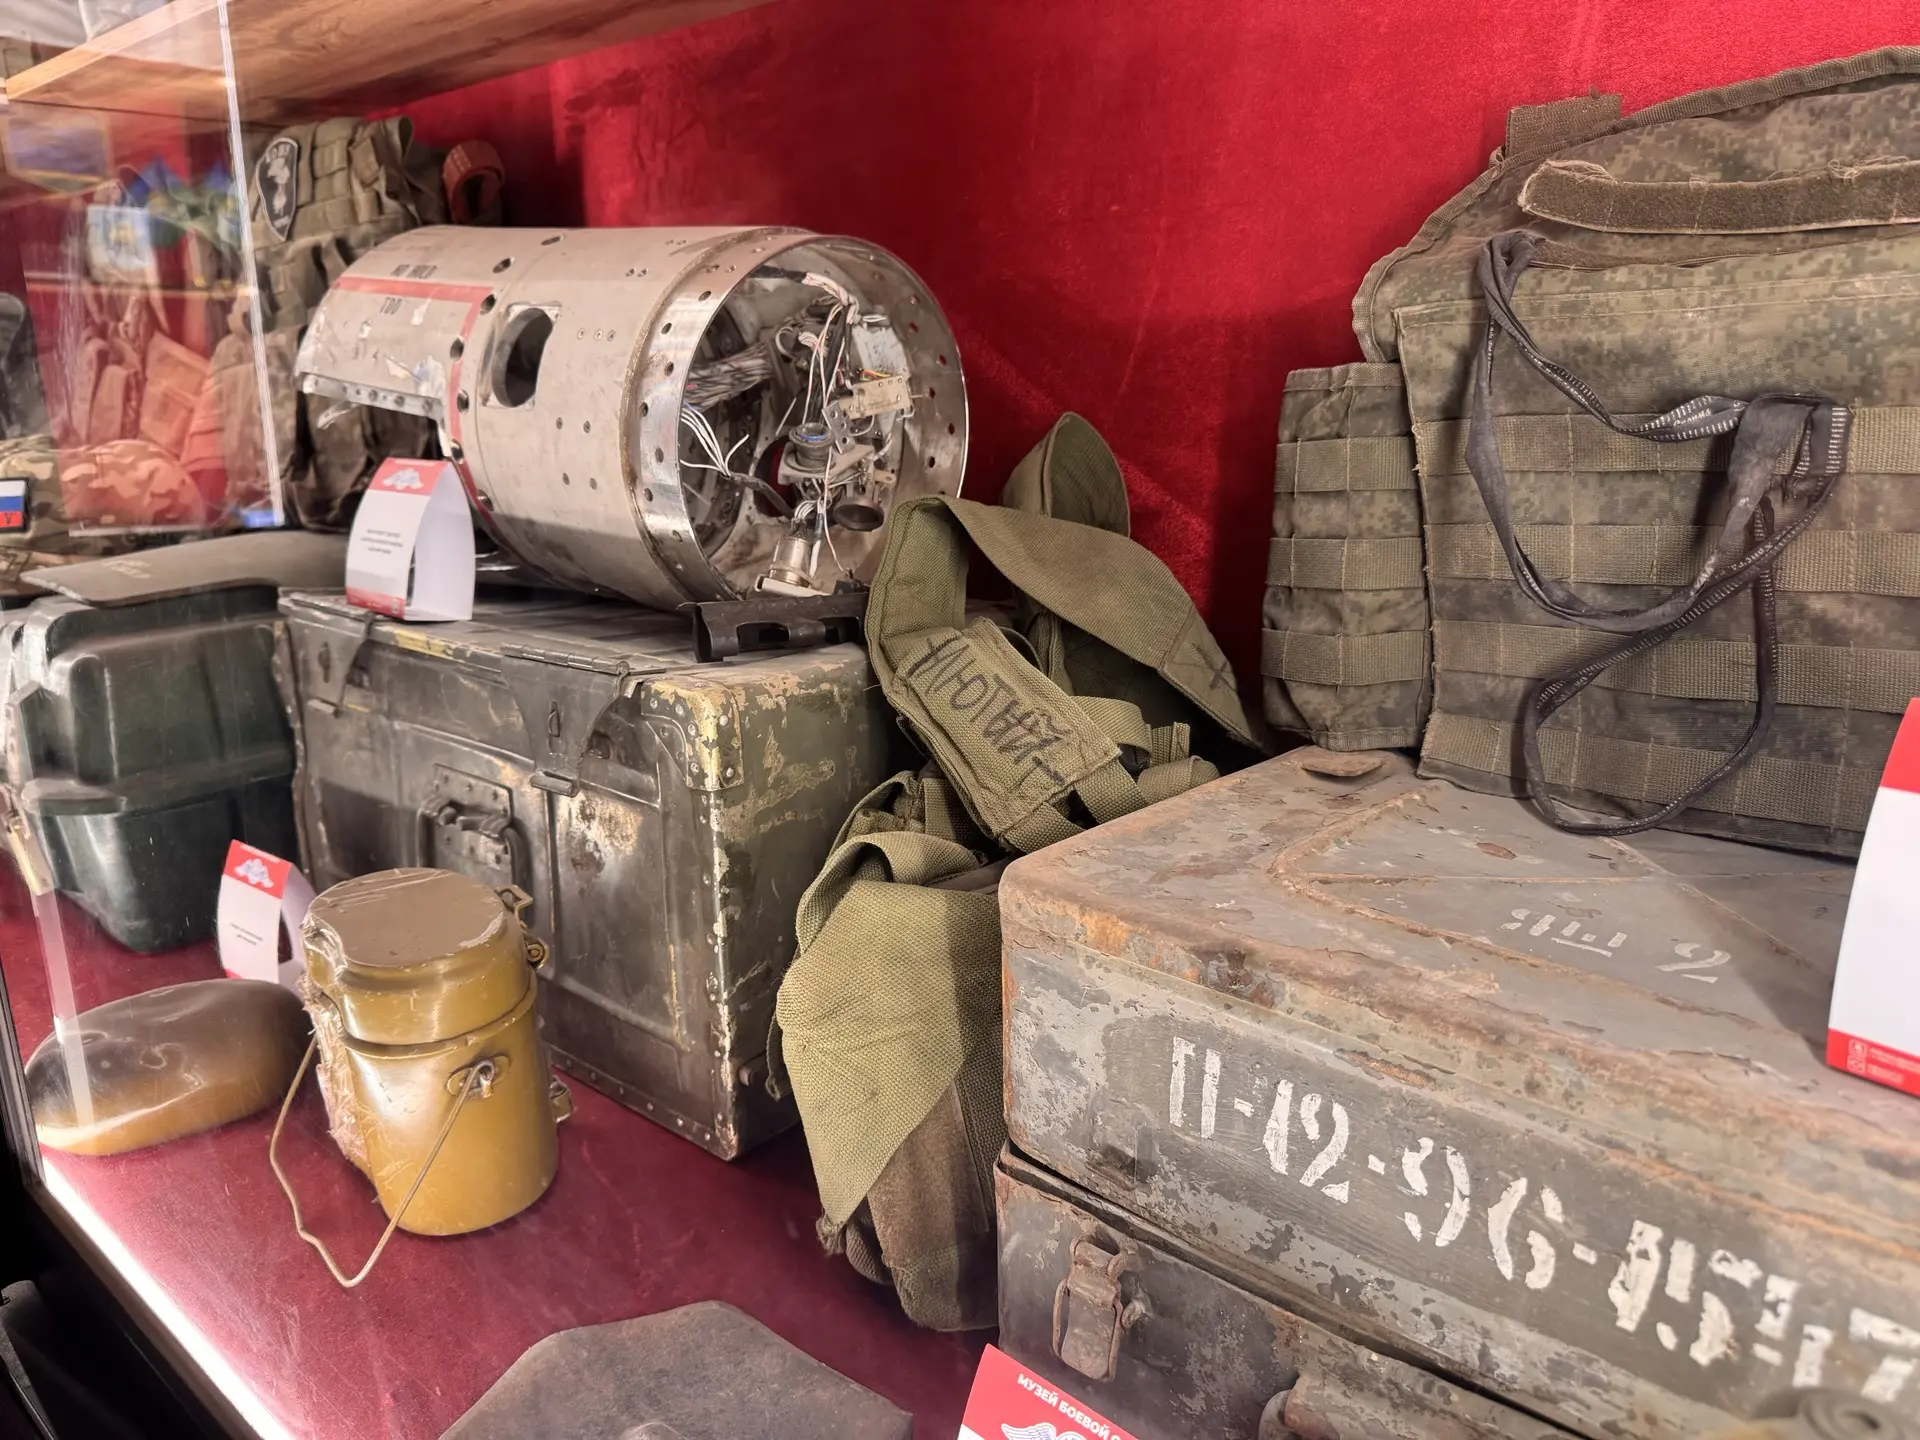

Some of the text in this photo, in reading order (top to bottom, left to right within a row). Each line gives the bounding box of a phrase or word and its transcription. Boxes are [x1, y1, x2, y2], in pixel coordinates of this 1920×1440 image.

[1655, 942, 1731, 984] 2
[1017, 1373, 1111, 1440] МУЗЕЙ БОЕВОЙ
